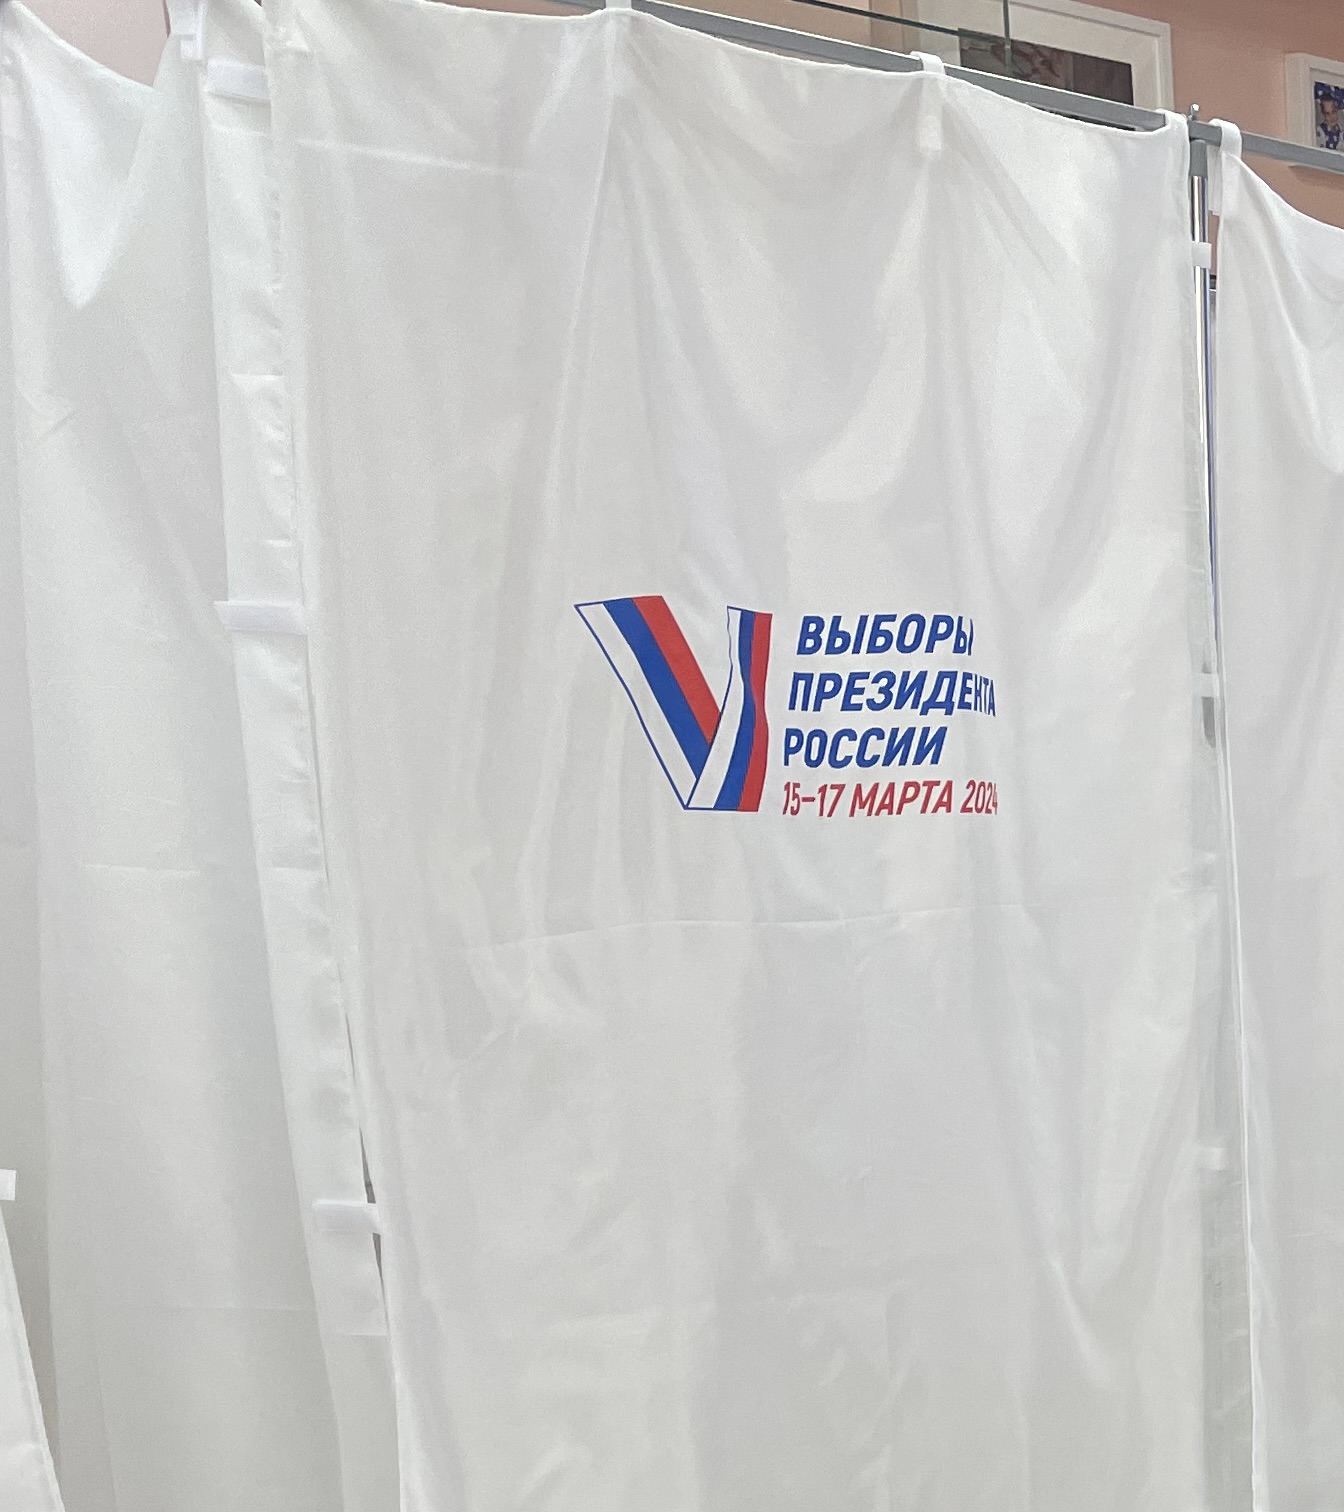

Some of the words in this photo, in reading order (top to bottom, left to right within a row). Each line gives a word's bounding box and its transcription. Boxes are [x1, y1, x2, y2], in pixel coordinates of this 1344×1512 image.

[797, 614, 974, 656] ВЫБОРЫ
[788, 671, 995, 717] ПРЕЗИДЕНТА
[784, 727, 947, 769] РОССИИ
[849, 780, 953, 818] МАРТА
